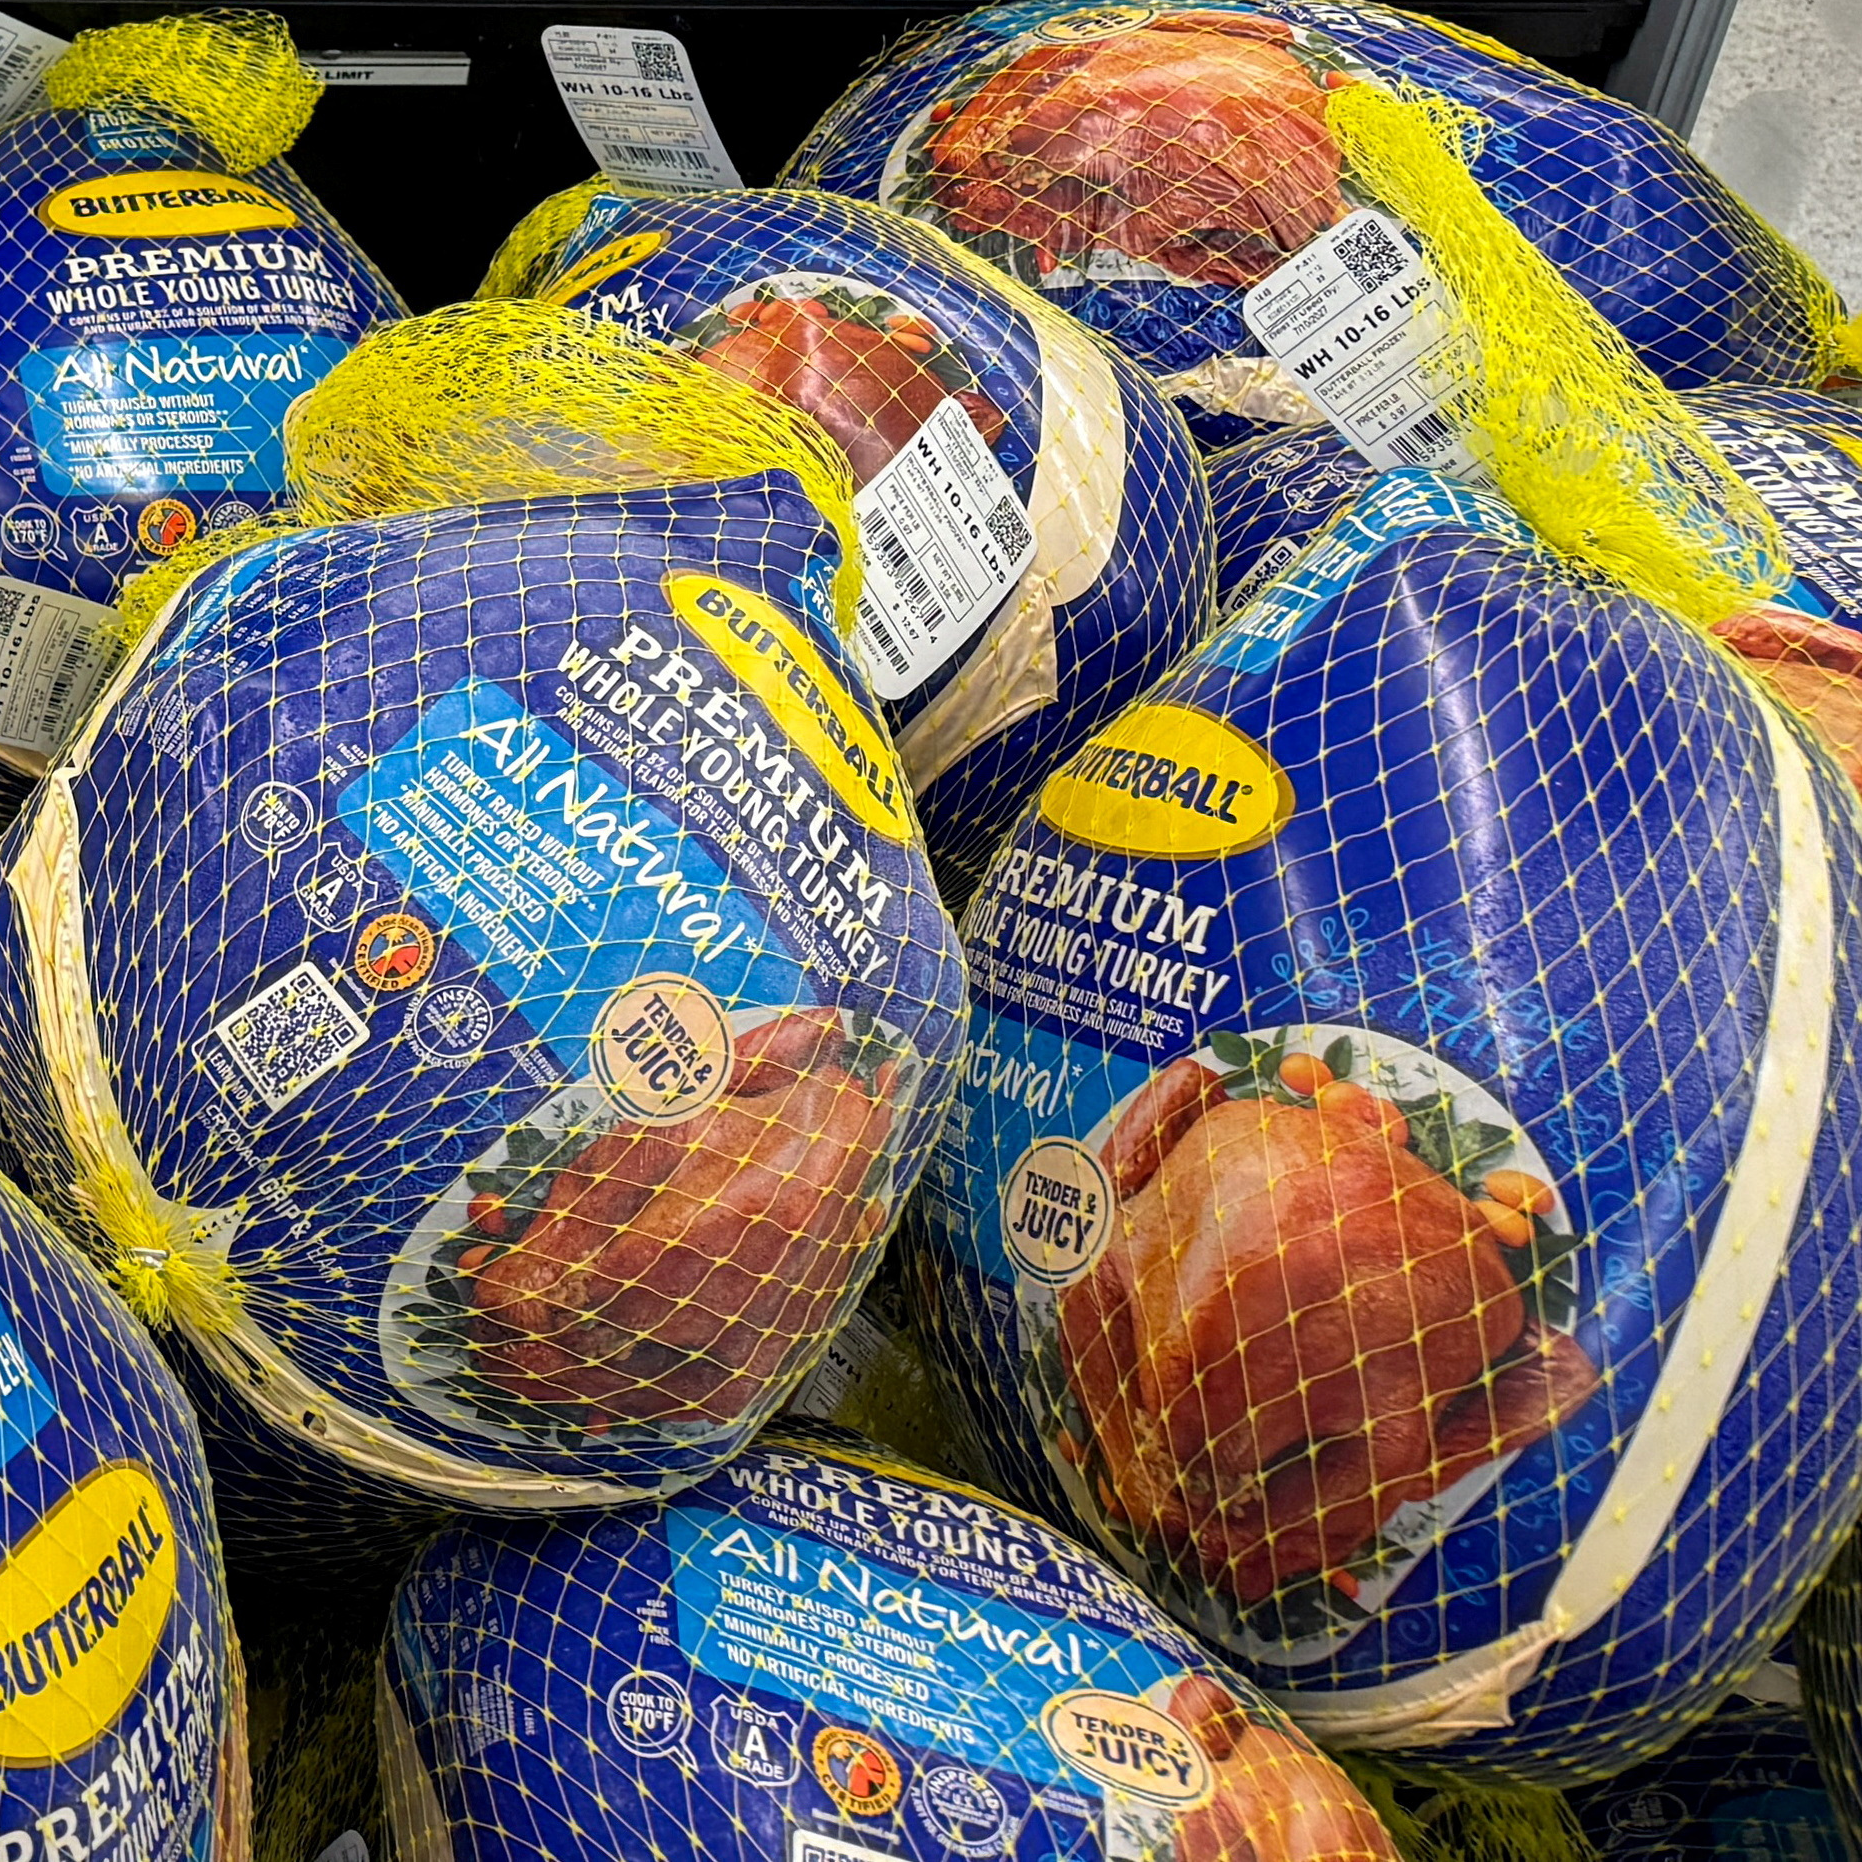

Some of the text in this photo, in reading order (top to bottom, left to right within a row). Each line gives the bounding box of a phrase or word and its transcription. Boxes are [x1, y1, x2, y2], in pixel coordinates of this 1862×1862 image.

[325, 70, 375, 81] LIMIT
[561, 80, 695, 102] WH 10-16 Lbs
[69, 186, 272, 220] BUTTERBALL
[64, 244, 332, 284] PREMIUM
[45, 274, 361, 315] WHOLE YOUNG TURKEY
[1291, 271, 1433, 383] WH 10-16 Lbs
[51, 347, 116, 392] All
[61, 394, 215, 412] TURKEY RAISED WITHOUT
[139, 435, 213, 451] PROCESSED
[162, 460, 244, 476] INGREDIENTS
[917, 436, 1008, 586] WH 10-16 Lbs
[694, 586, 903, 816] BUTTERBALL
[466, 714, 550, 786] All
[608, 624, 894, 920] PREMIUM
[556, 638, 891, 986] WHOLE YOUNG TURKEY
[985, 846, 1219, 955] PREMIUM
[1009, 920, 1231, 1017] YOUNG TURKEY
[611, 1017, 697, 1105] JUICY
[1011, 1199, 1096, 1256] JUICY
[727, 1467, 1049, 1575] WHOLE YOUNG
[708, 1529, 801, 1587] All
[619, 1675, 676, 1711] COOK TO
[1078, 1735, 1195, 1792] JUICY
